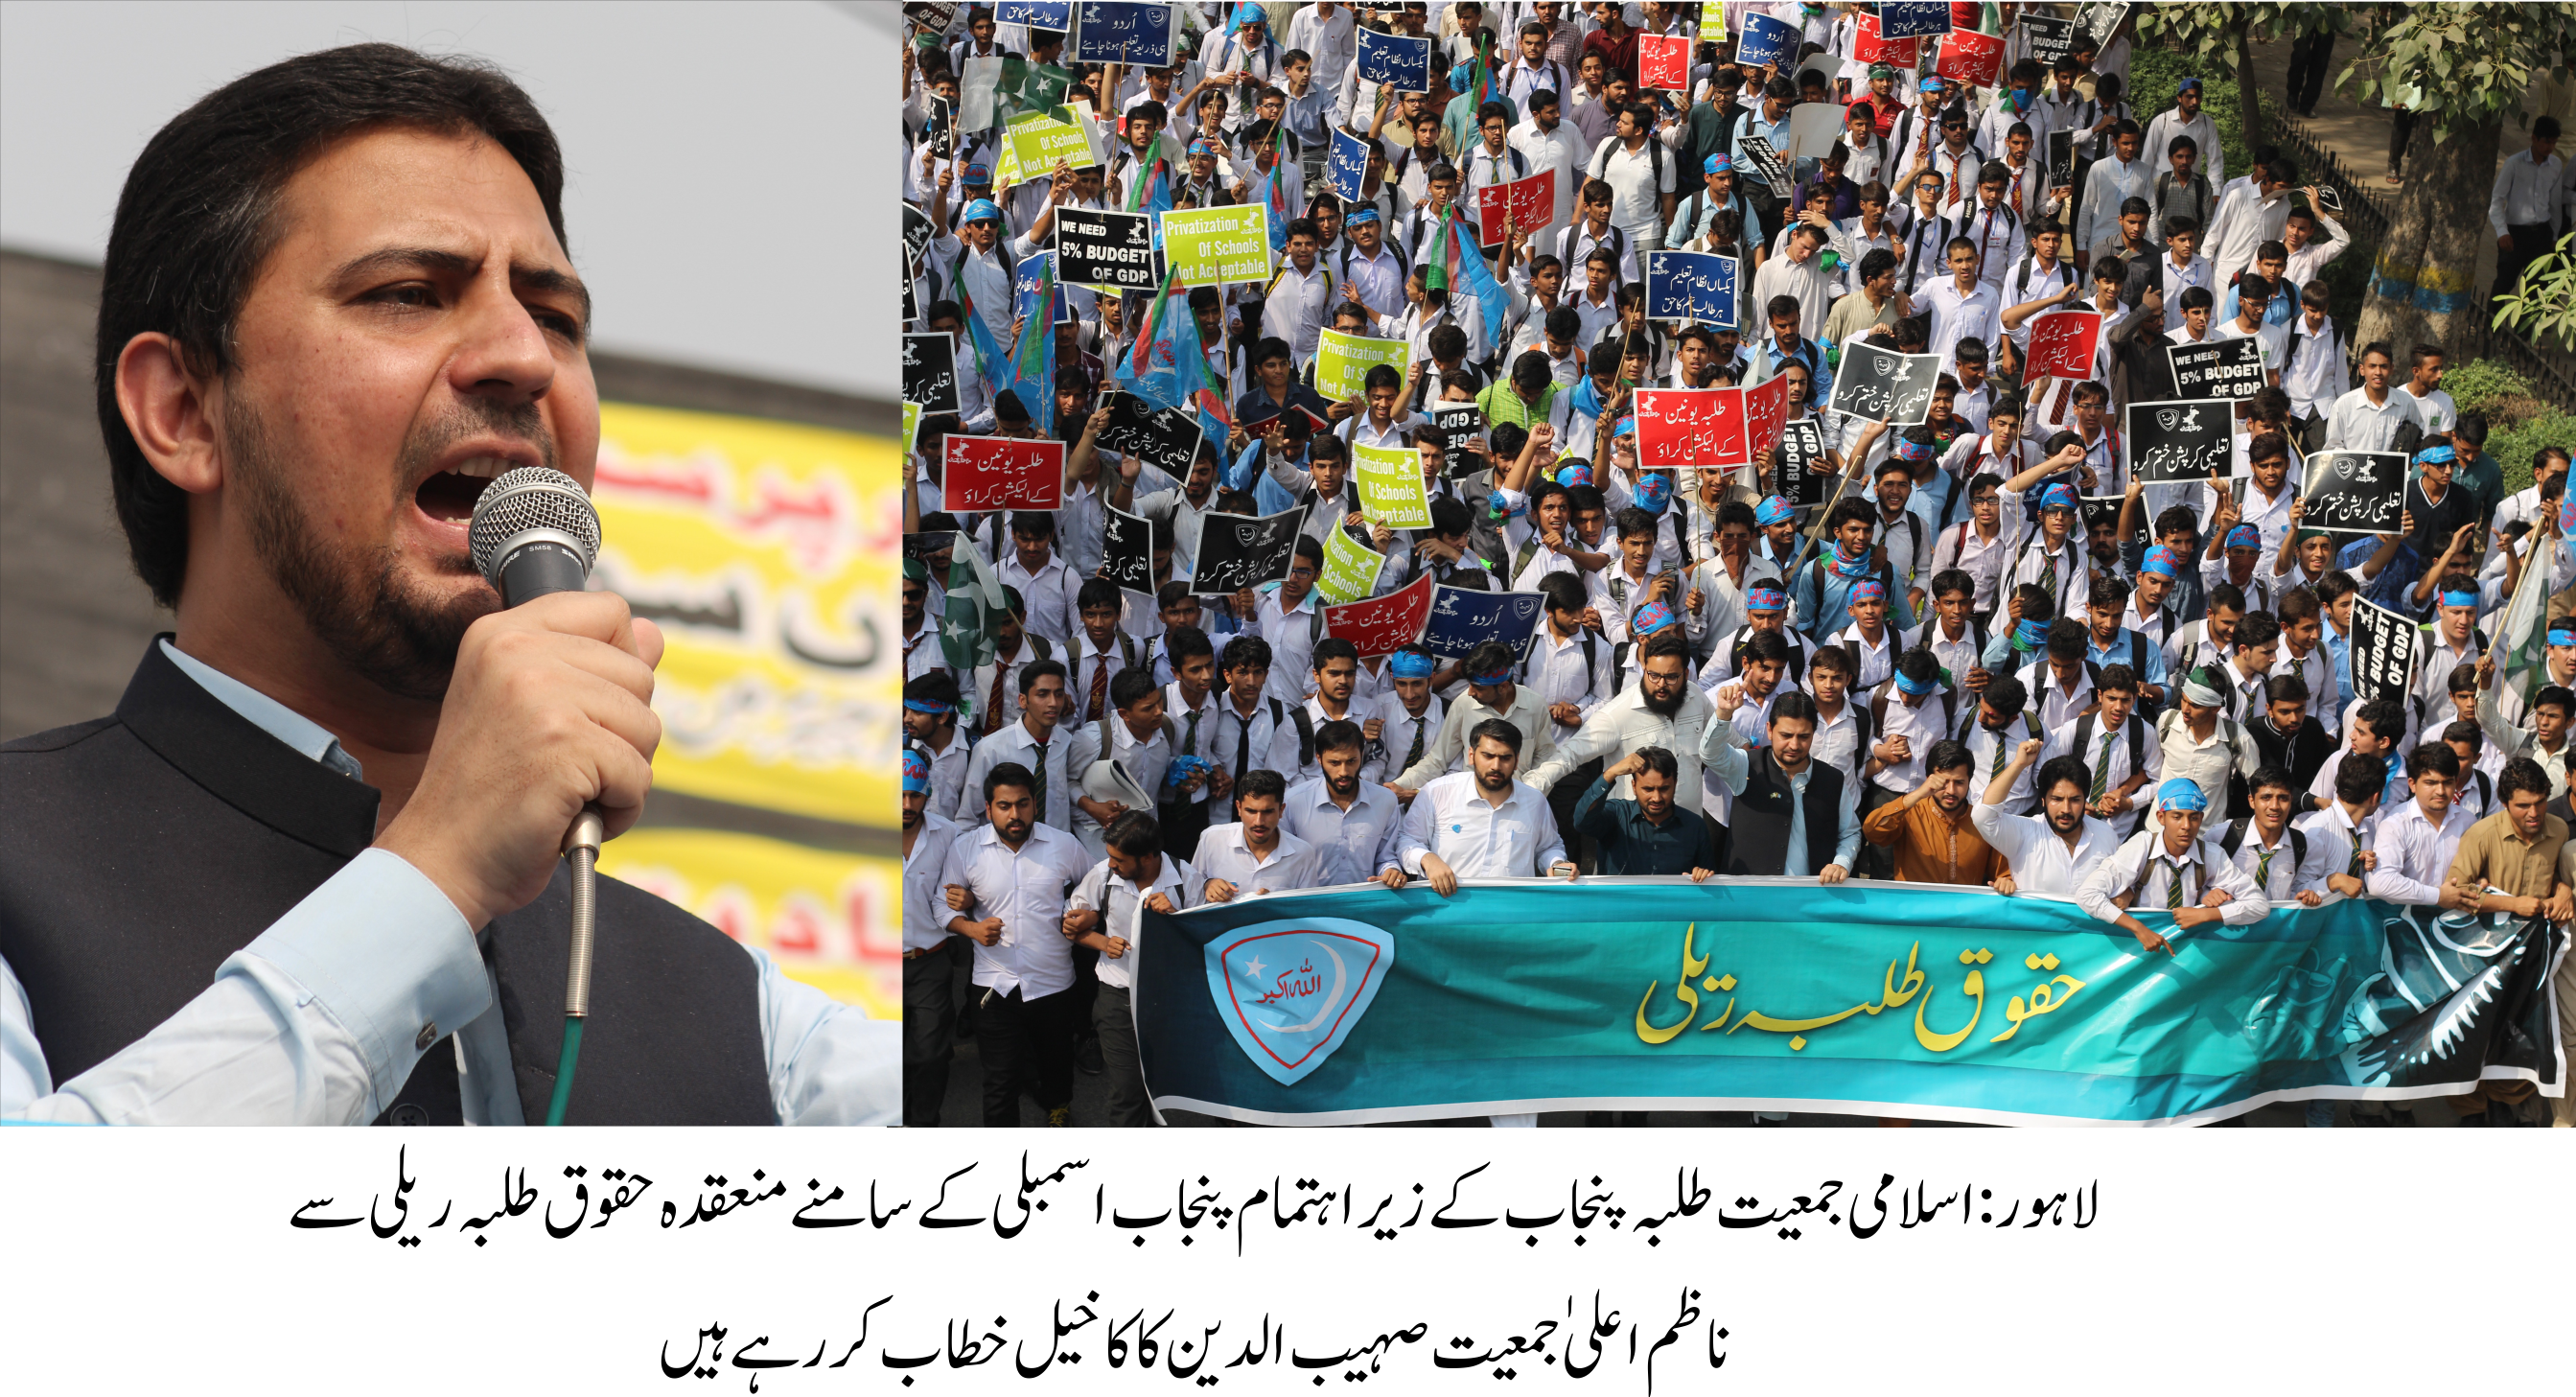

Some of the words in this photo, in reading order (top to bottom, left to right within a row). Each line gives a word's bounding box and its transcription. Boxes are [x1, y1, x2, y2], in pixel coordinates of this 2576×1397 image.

[918, 9, 929, 19] OF
[928, 14, 948, 29] GDP
[2030, 24, 2048, 33] NEED
[2032, 36, 2070, 50] BUDGET
[1040, 136, 1052, 150] Of
[1053, 132, 1084, 148] Schools
[1023, 157, 1041, 174] Not
[1061, 220, 1076, 233] WE
[1079, 222, 1106, 237] NEED
[1167, 218, 1239, 237] Privatization
[1061, 242, 1081, 259] 5%
[1086, 244, 1149, 264] BUDGET
[1198, 242, 1212, 258] Of
[1215, 238, 1260, 256] Schools
[1092, 267, 1112, 280] OF
[1117, 268, 1149, 284] GDP
[2060, 320, 2084, 341] طلبہ
[1322, 337, 1383, 361] Privatization
[2175, 356, 2192, 366] WE
[2193, 351, 2220, 362] NEED
[1344, 364, 1355, 380] Of
[2180, 370, 2201, 384] 5%
[2205, 363, 2261, 381] BUDGET
[921, 371, 951, 405] تعلیمی
[1320, 378, 1337, 395] Not
[1854, 385, 1877, 412] ختم
[2212, 384, 2229, 396] OF
[2233, 382, 2262, 396] GDP
[1701, 400, 1726, 426] طلبہ
[1898, 387, 1929, 416] تعلیمی
[1717, 434, 1740, 456] کے
[1799, 426, 1818, 454] GDP
[1015, 452, 1044, 475] طلبہ
[1356, 452, 1395, 476] Privatization
[2153, 443, 2170, 479] ختم
[2200, 438, 2229, 472] تعلیمی
[1029, 484, 1053, 502] کے
[1368, 480, 1375, 498] Of
[1376, 482, 1417, 501] Schools
[1786, 484, 1800, 503] 5%
[2325, 491, 2345, 525] ختم
[2372, 491, 2402, 524] تعلیمی
[1324, 566, 1362, 597] Schools
[1397, 594, 1419, 620] طلبہ
[2369, 611, 2391, 684] BUDGET
[2392, 622, 2410, 661] GDP
[2357, 646, 2366, 680] NEED
[2387, 660, 2404, 687] OF
[1256, 969, 1294, 1004] اکبر
[1289, 958, 1321, 998] اللہ
[1636, 921, 1737, 1044] ریلی
[1727, 940, 1926, 1051] طلبہ
[1915, 946, 2086, 1052] حقوق
